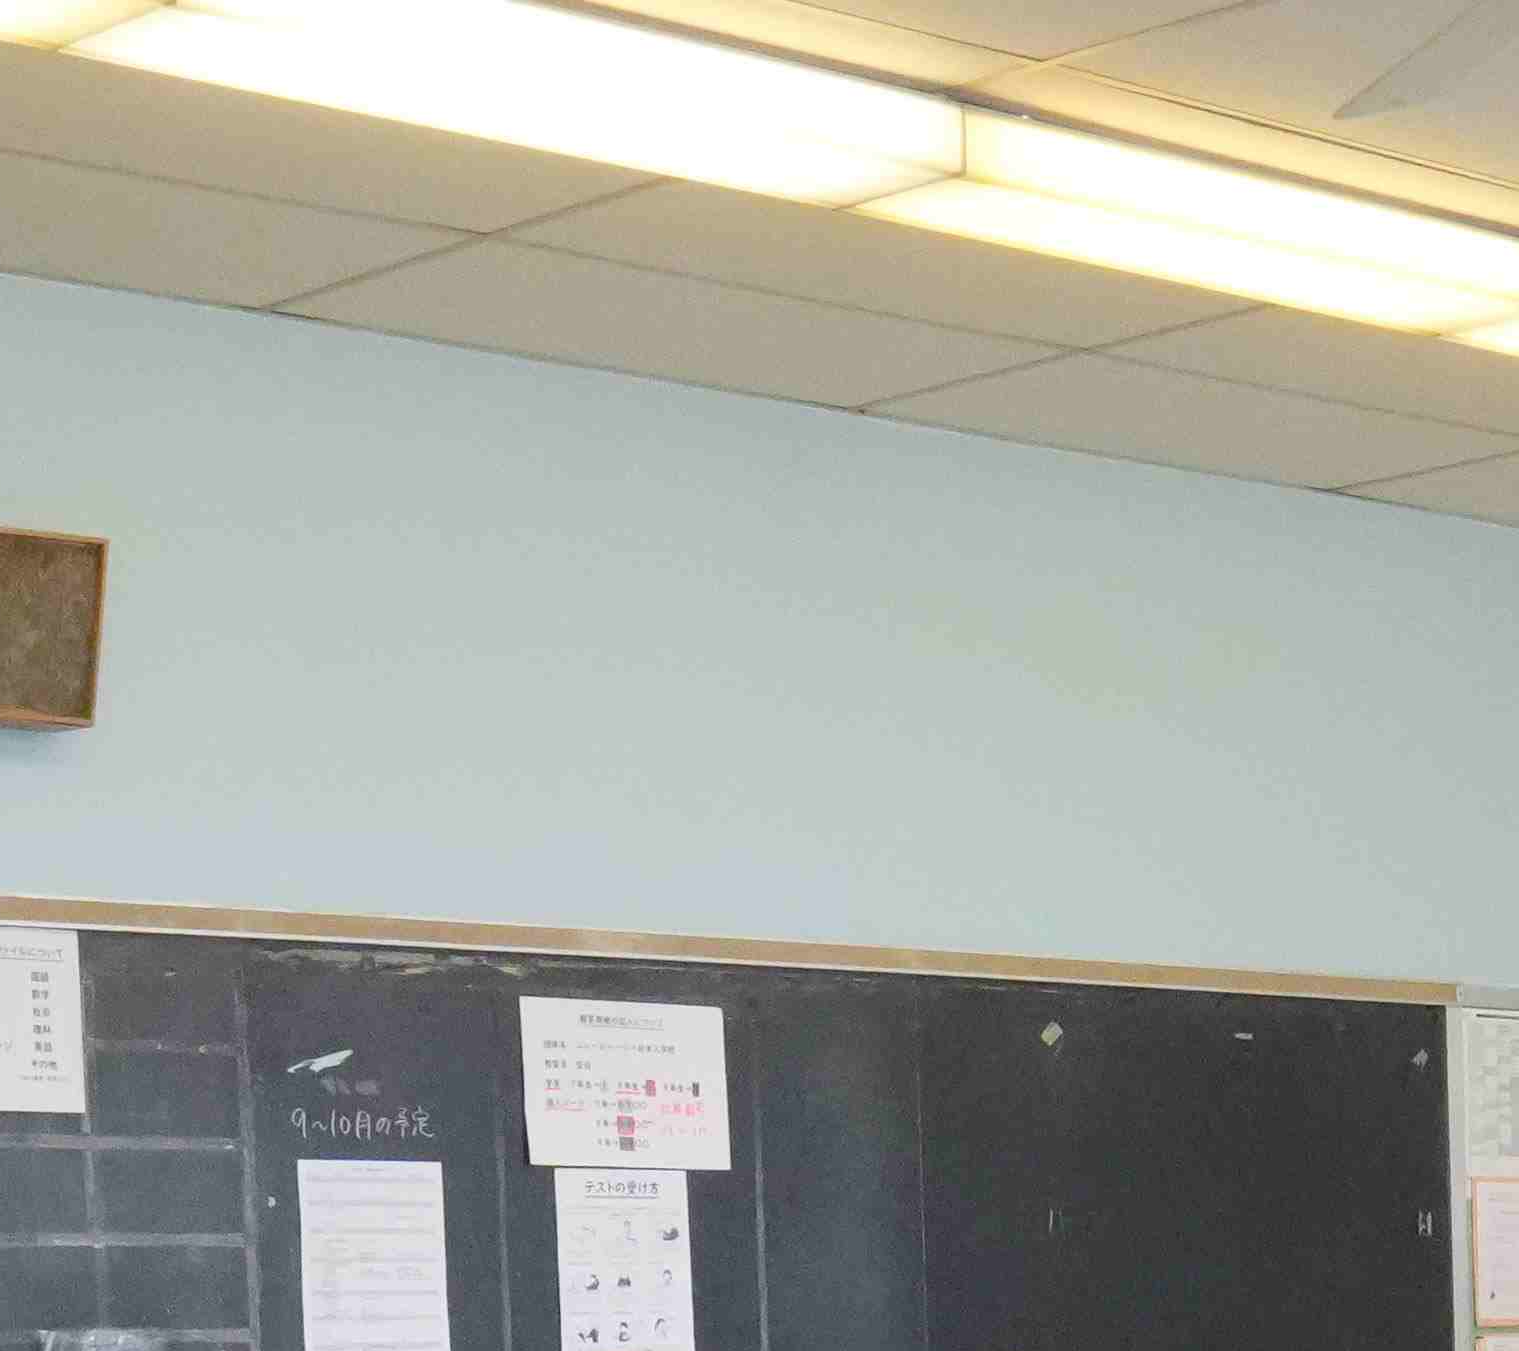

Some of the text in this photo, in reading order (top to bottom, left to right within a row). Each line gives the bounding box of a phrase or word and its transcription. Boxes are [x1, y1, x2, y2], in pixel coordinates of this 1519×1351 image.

[585, 1181, 660, 1195] テストの受け方
